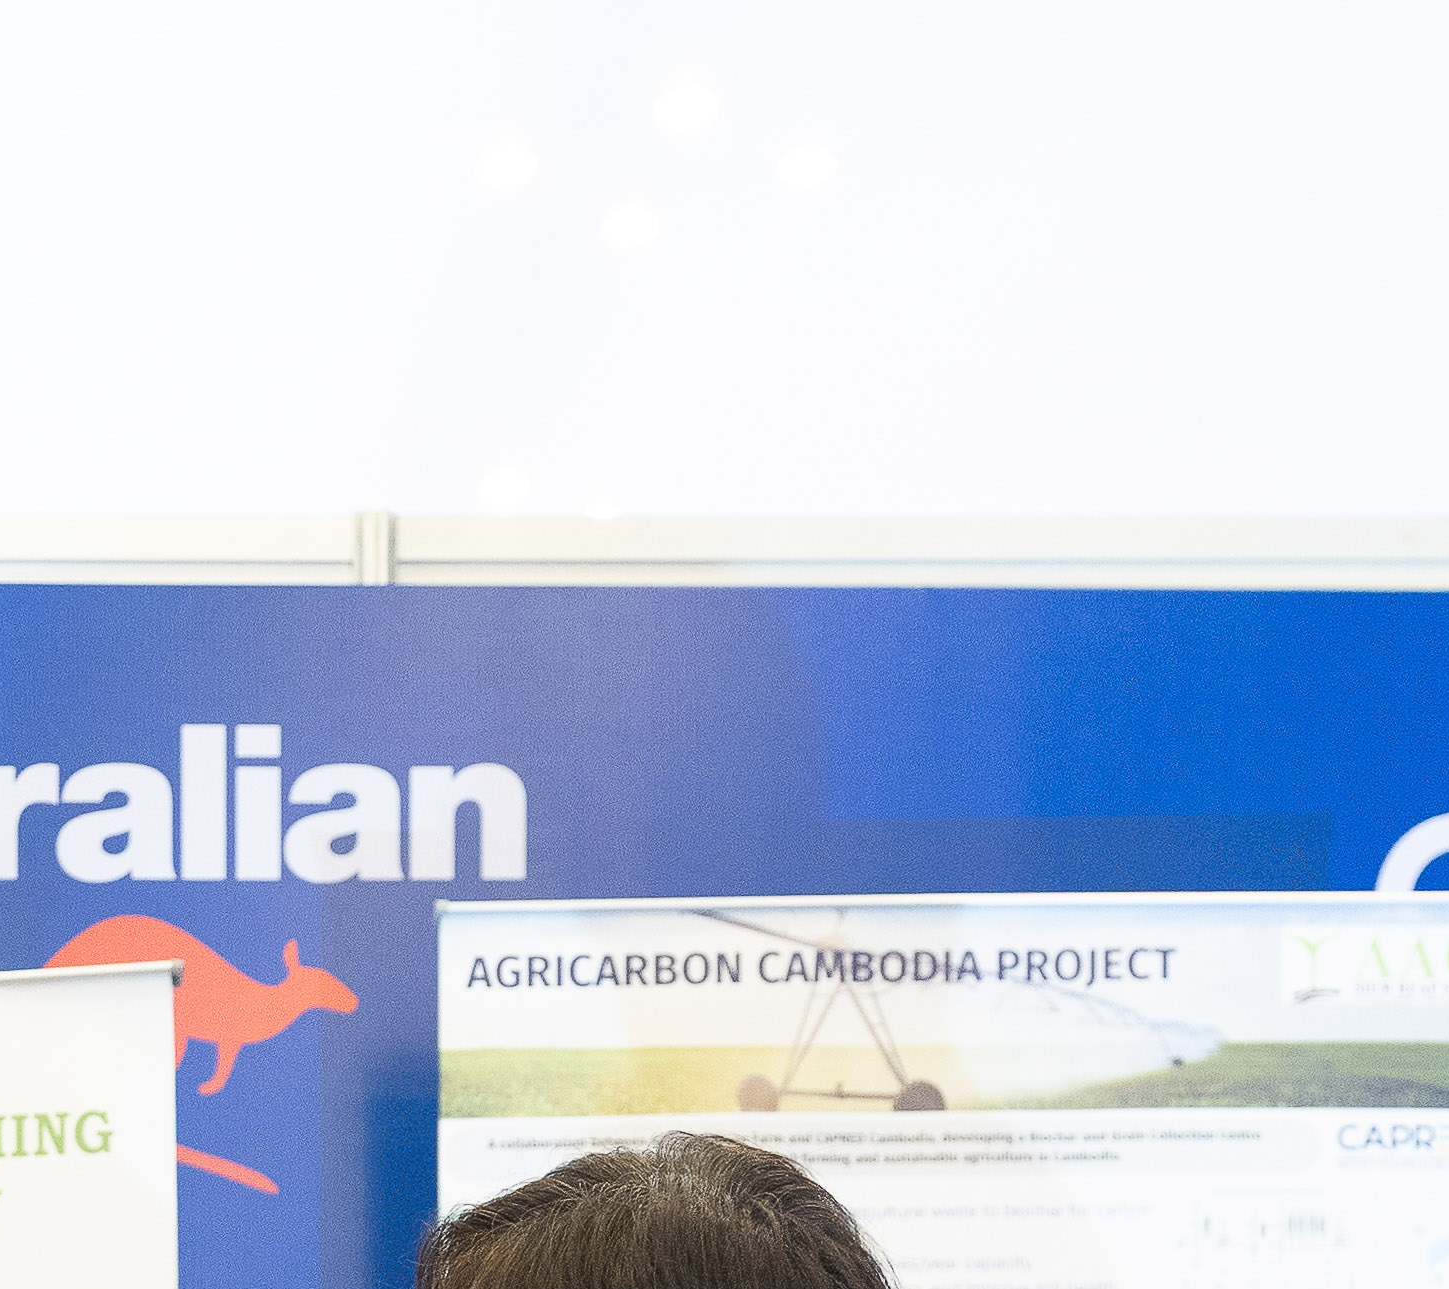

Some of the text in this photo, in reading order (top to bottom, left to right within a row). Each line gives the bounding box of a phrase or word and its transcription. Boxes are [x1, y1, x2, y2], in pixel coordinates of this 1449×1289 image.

[466, 944, 1177, 989] AGRICARBON CAMBODIA PROJECT
